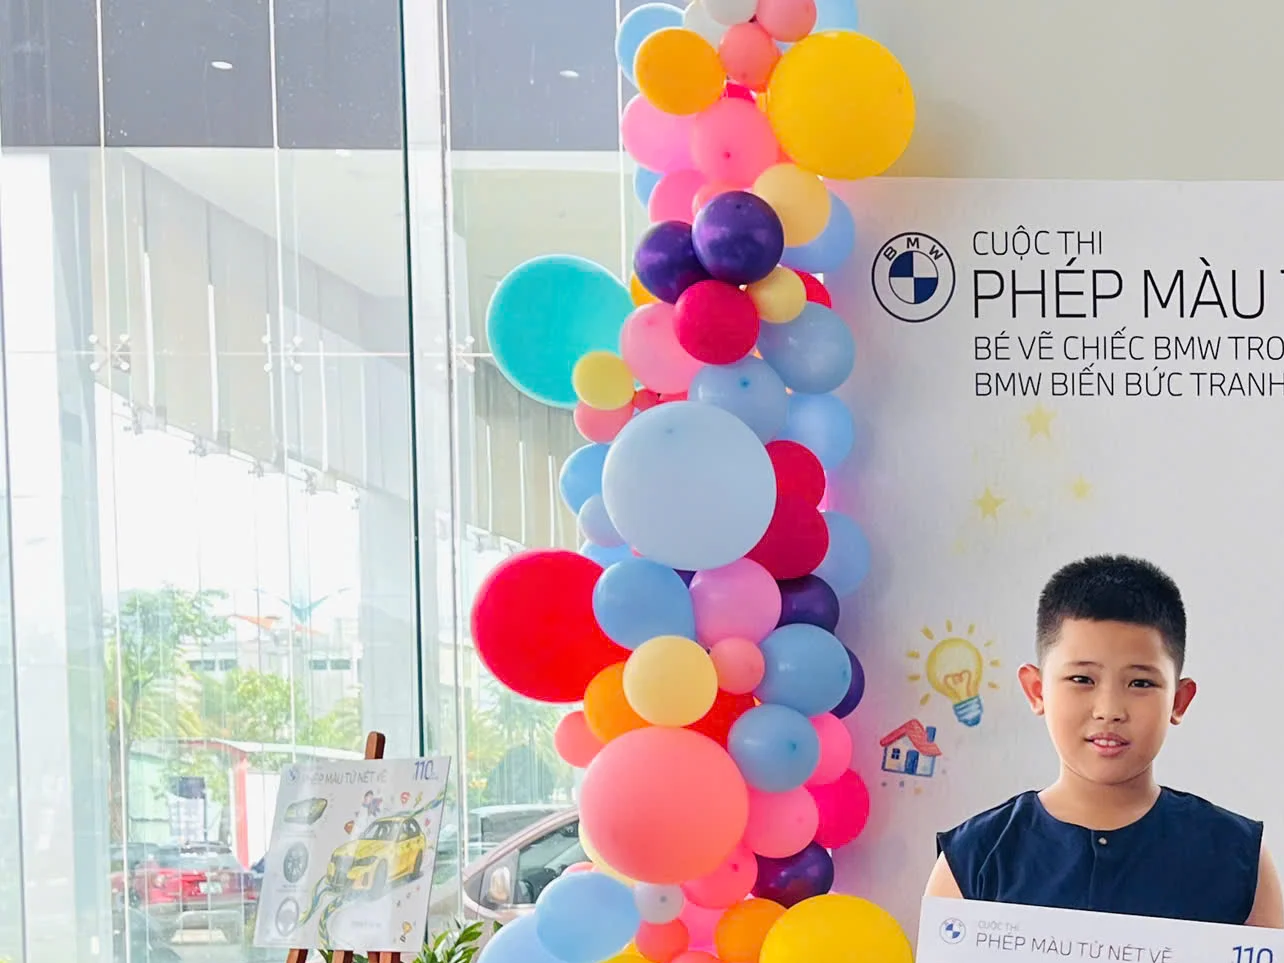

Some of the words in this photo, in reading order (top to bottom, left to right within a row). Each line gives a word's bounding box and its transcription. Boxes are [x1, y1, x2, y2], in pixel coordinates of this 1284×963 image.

[883, 236, 944, 262] BMW
[972, 224, 1051, 261] CUỘC
[1056, 230, 1103, 255] THI
[973, 256, 1124, 319] PHÉP
[1143, 256, 1266, 320] MÀU
[974, 330, 1011, 361] BÉ
[1017, 330, 1055, 361] VẼ
[1062, 326, 1145, 361] CHIẾC
[1153, 335, 1222, 361] BMW
[975, 372, 1043, 397] BMW
[1050, 362, 1115, 397] BIẾN
[1124, 365, 1183, 397] BỨC
[975, 932, 1026, 951] PHÉP
[1031, 936, 1073, 957] MÀU
